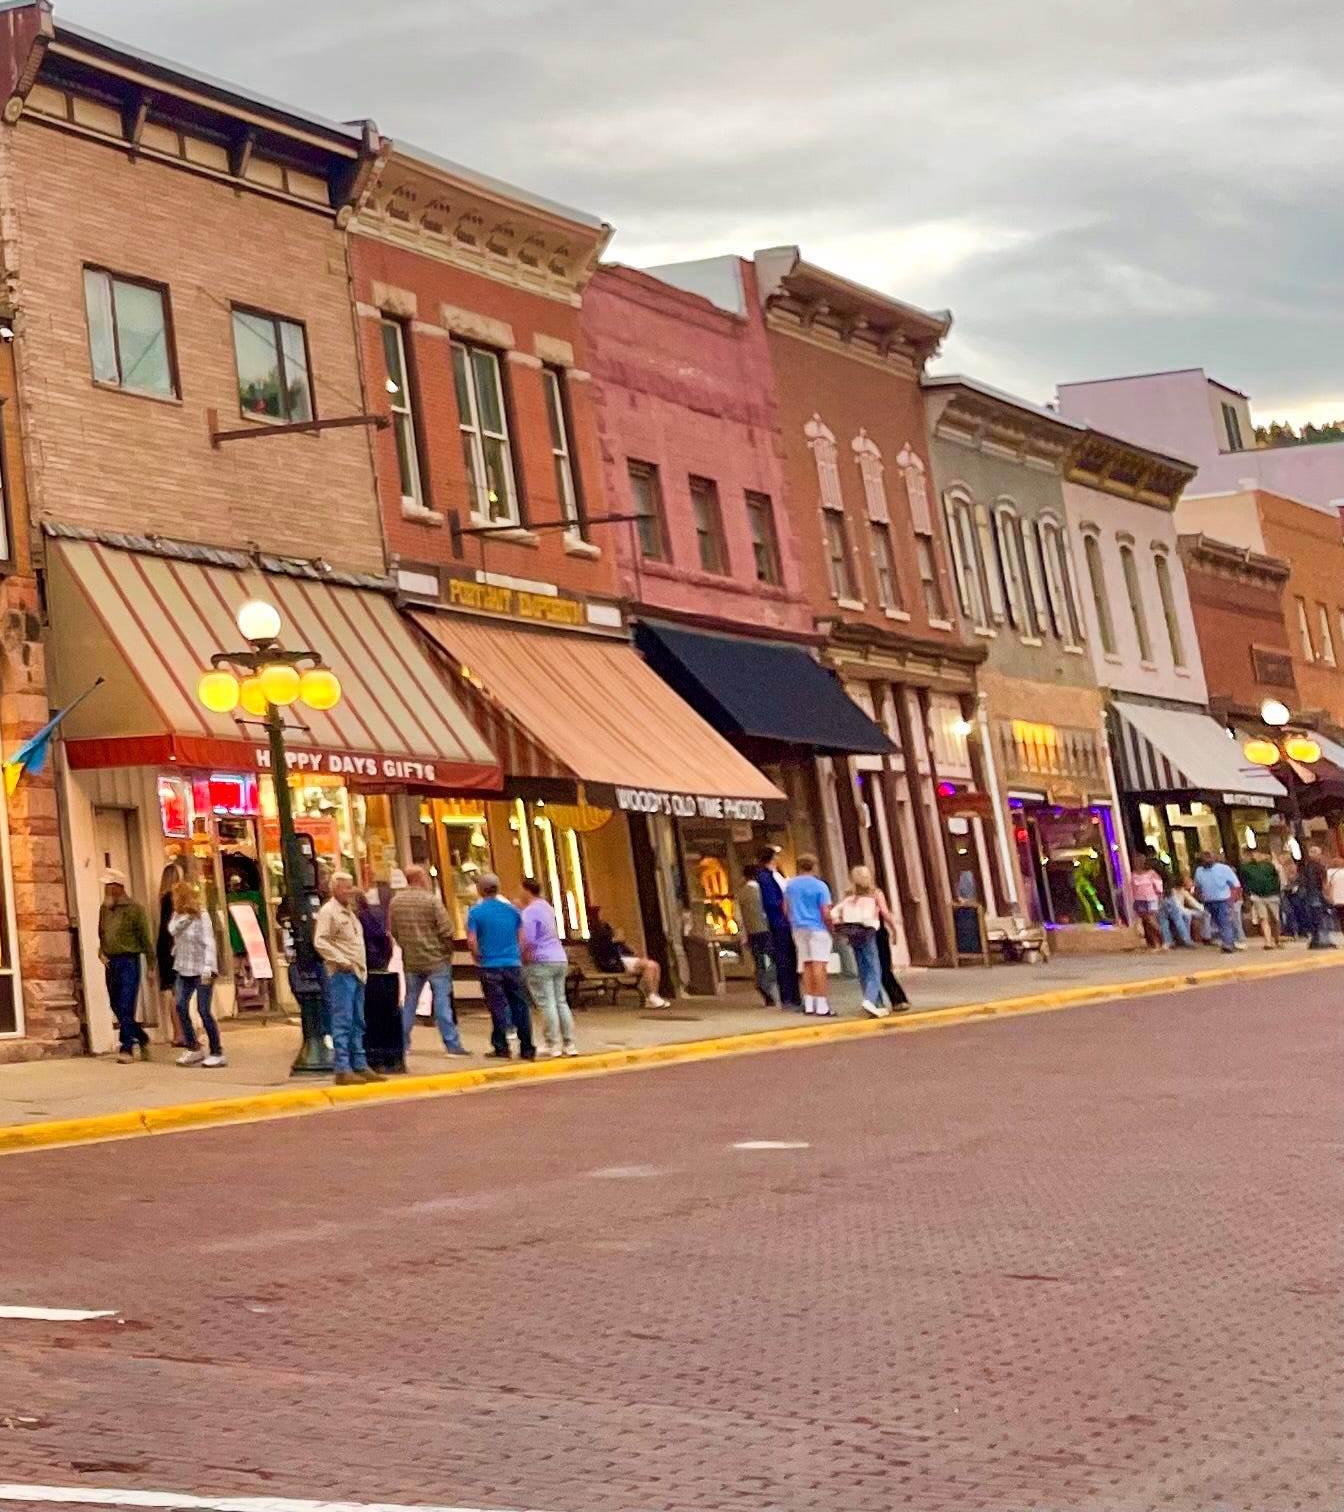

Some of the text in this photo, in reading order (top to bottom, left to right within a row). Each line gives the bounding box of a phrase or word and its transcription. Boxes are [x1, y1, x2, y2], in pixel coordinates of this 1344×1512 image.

[256, 749, 435, 781] HPPY DAYS GIFTS
[671, 794, 697, 817] OLD
